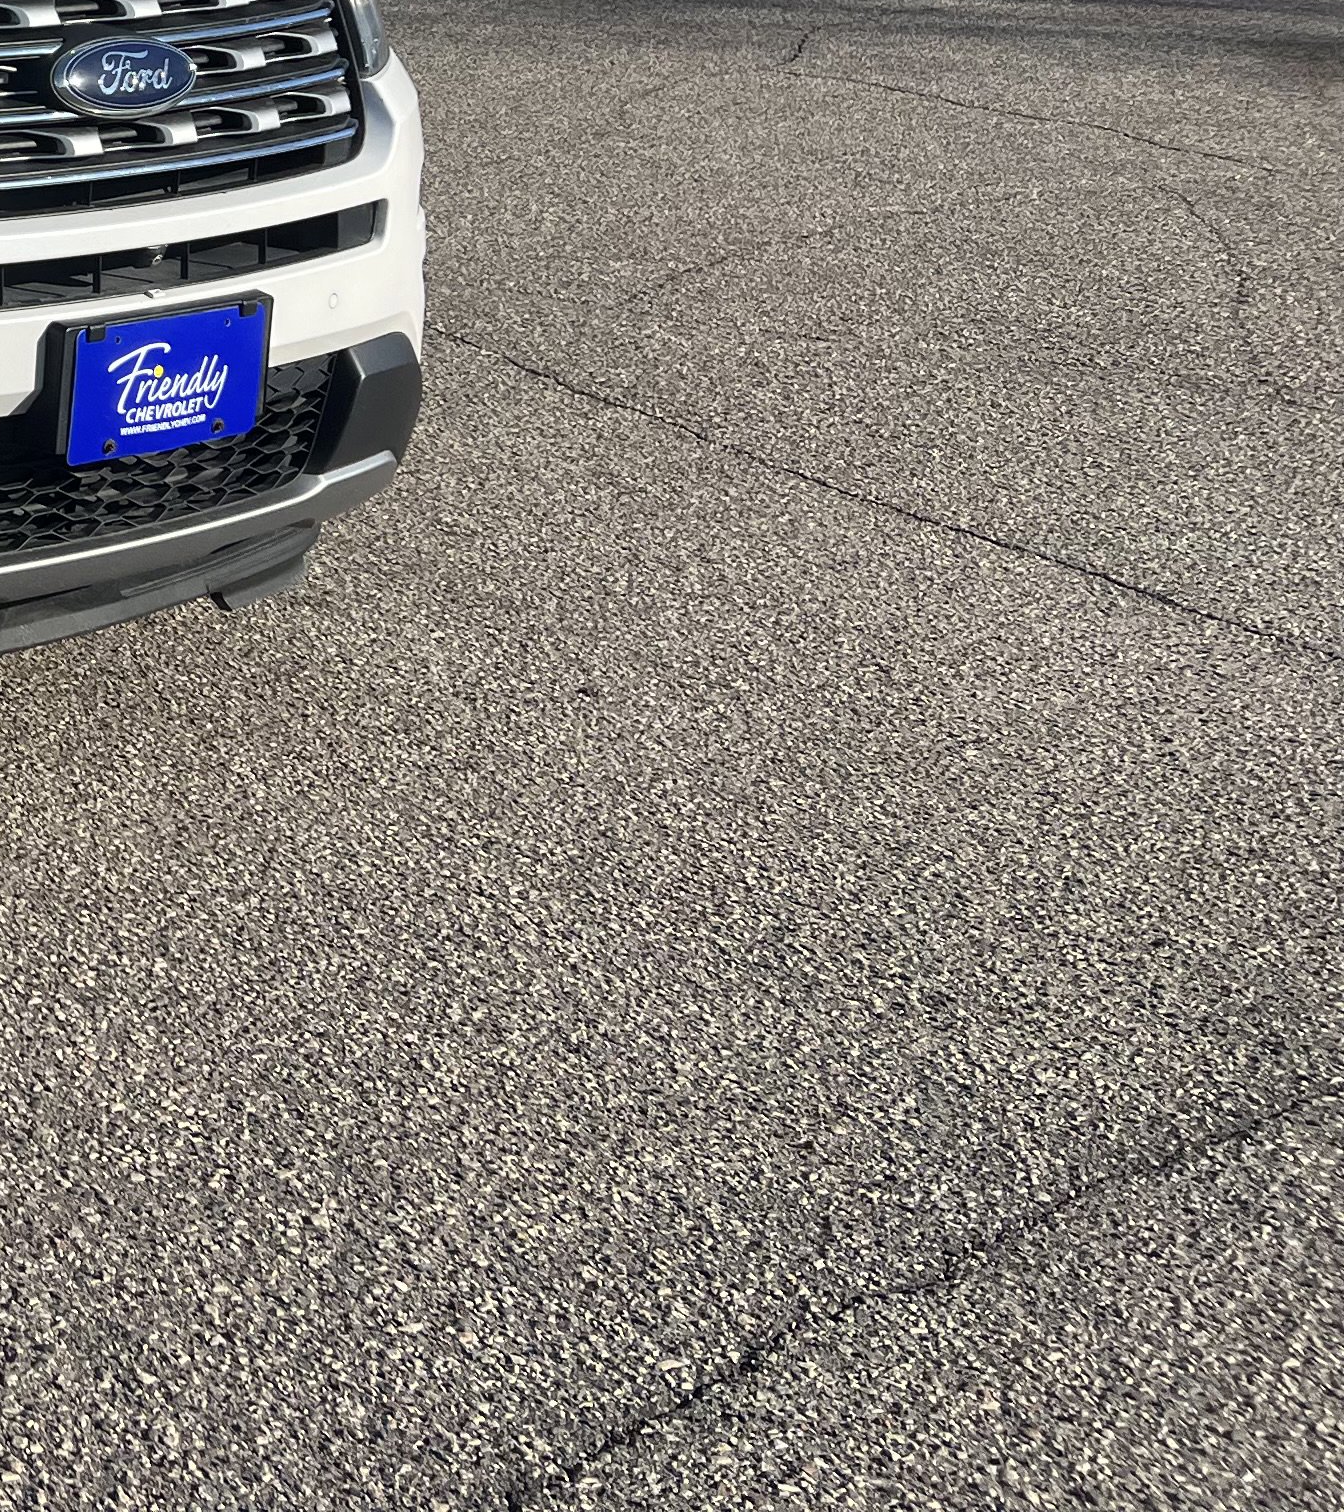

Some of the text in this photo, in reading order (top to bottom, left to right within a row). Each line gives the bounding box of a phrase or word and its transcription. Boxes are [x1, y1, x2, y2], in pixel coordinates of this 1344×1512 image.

[98, 49, 173, 96] Ford
[108, 342, 229, 415] Friendly
[125, 397, 204, 424] CHEVROLET
